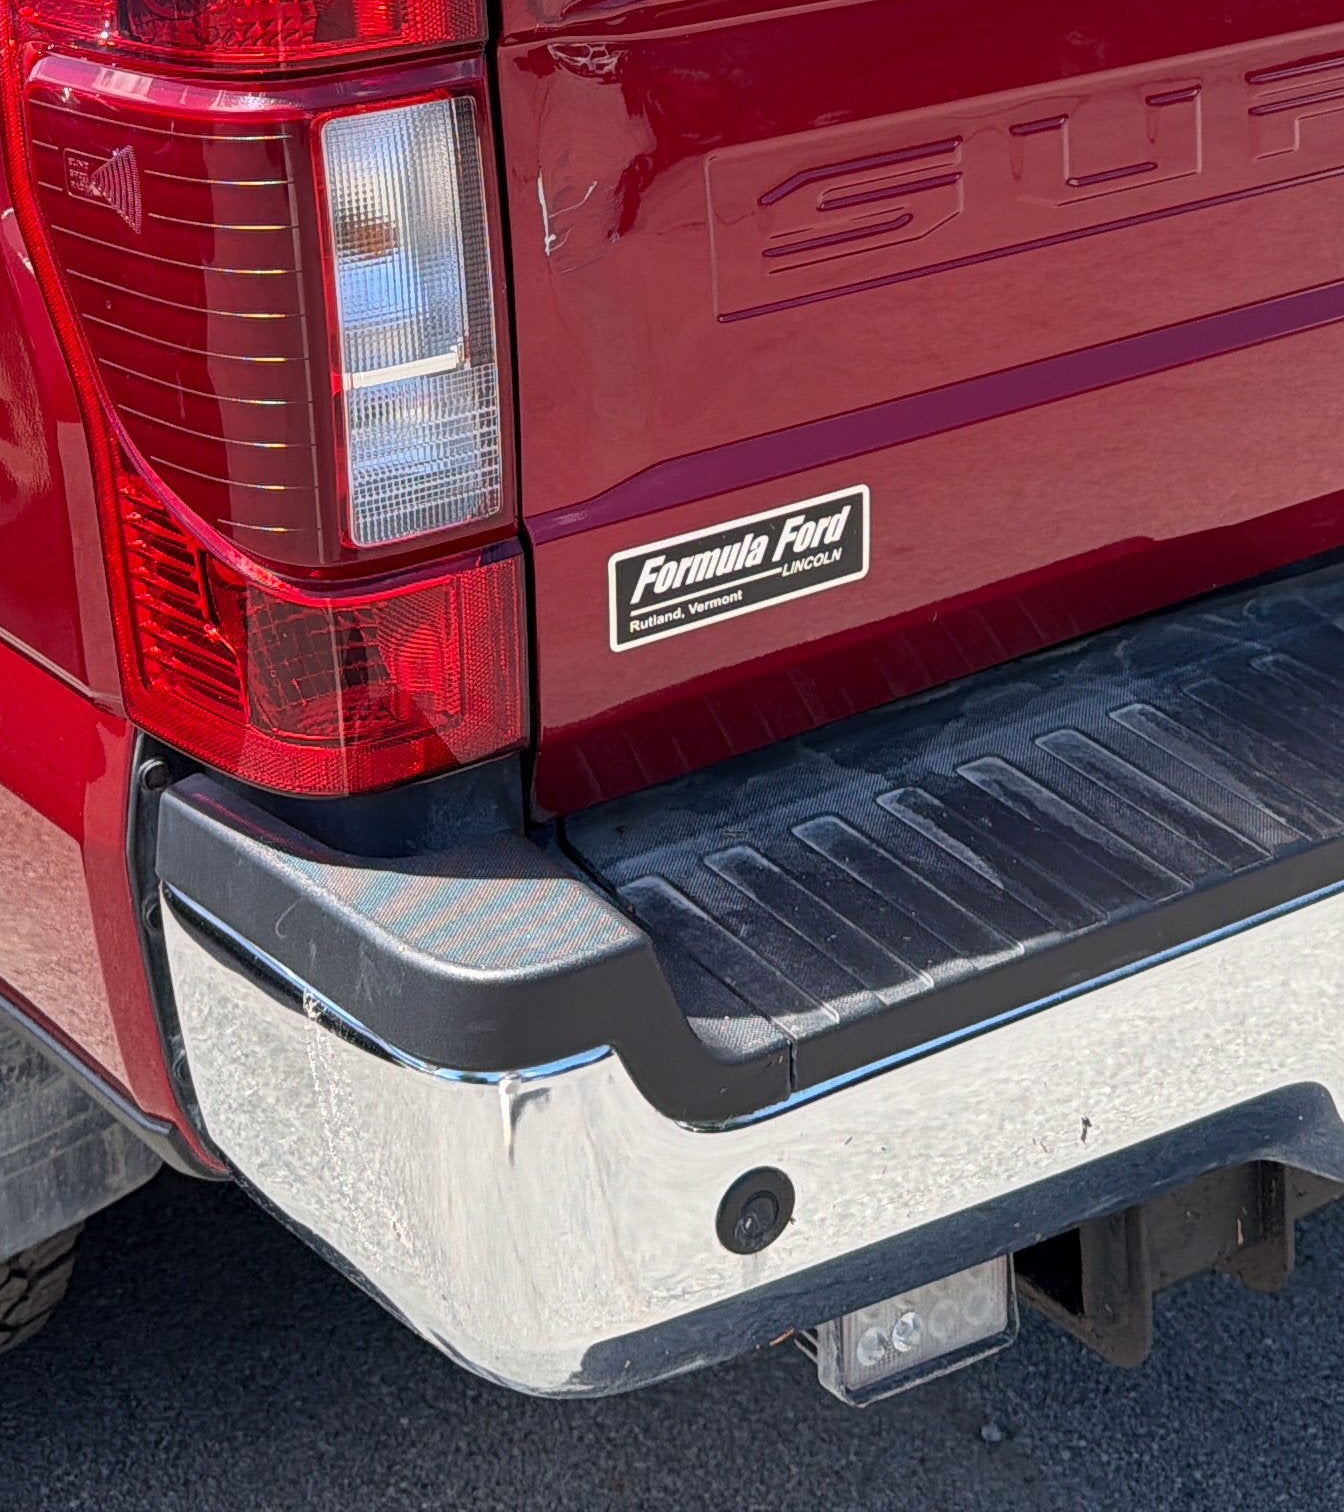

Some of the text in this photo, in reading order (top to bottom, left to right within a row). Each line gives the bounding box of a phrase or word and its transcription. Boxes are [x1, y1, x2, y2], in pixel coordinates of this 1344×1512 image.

[629, 504, 852, 605] Formula Ford
[781, 547, 843, 578] LINCOLN
[629, 589, 744, 634] Rutland, Vermont
